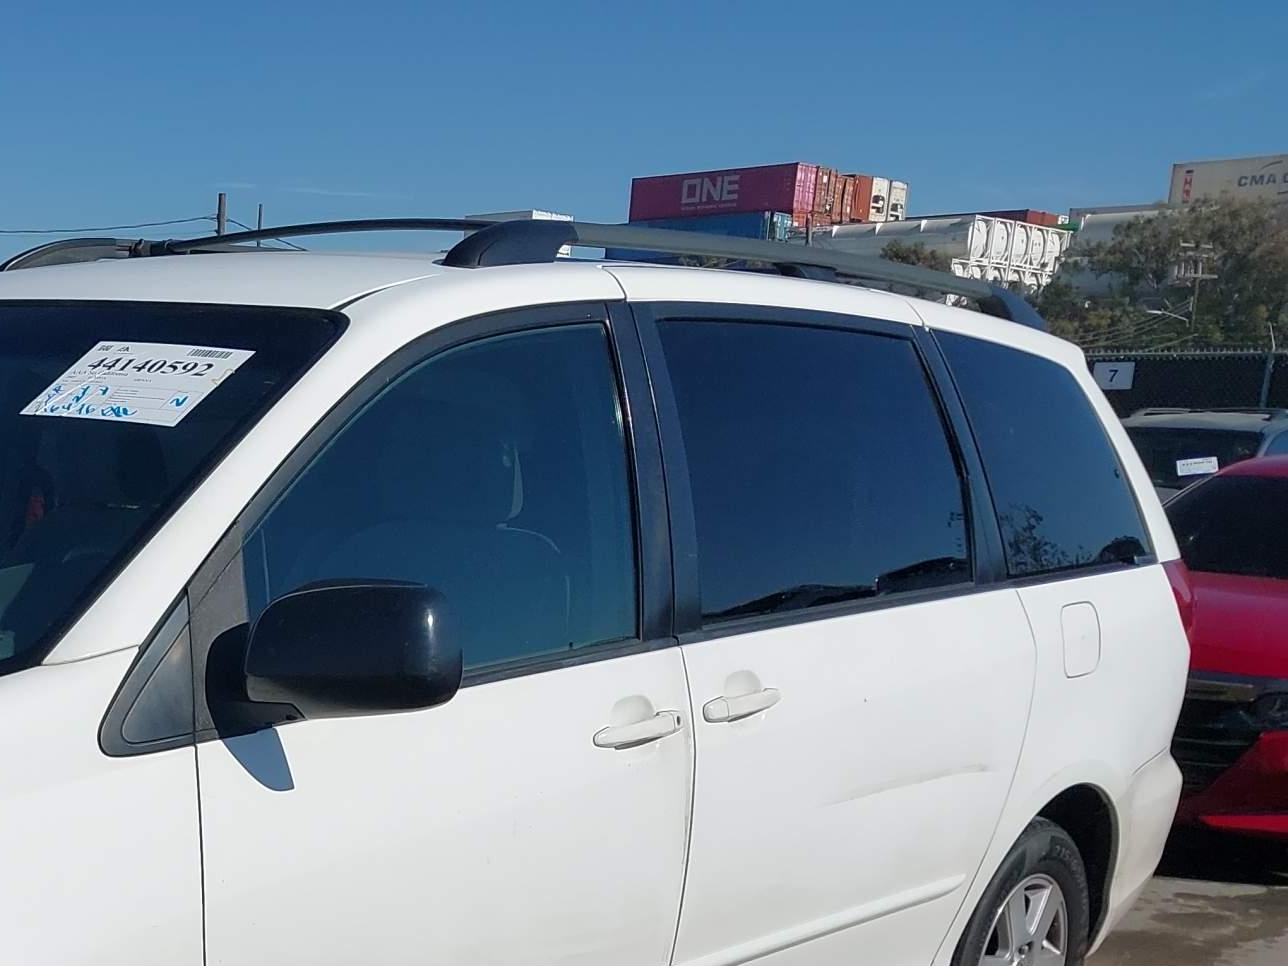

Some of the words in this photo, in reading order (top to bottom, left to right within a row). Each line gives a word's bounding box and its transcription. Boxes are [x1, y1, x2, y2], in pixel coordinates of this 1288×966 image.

[680, 174, 742, 204] ONE
[1237, 174, 1277, 188] CMA
[87, 356, 215, 377] 44140592
[1108, 369, 1119, 382] 7
